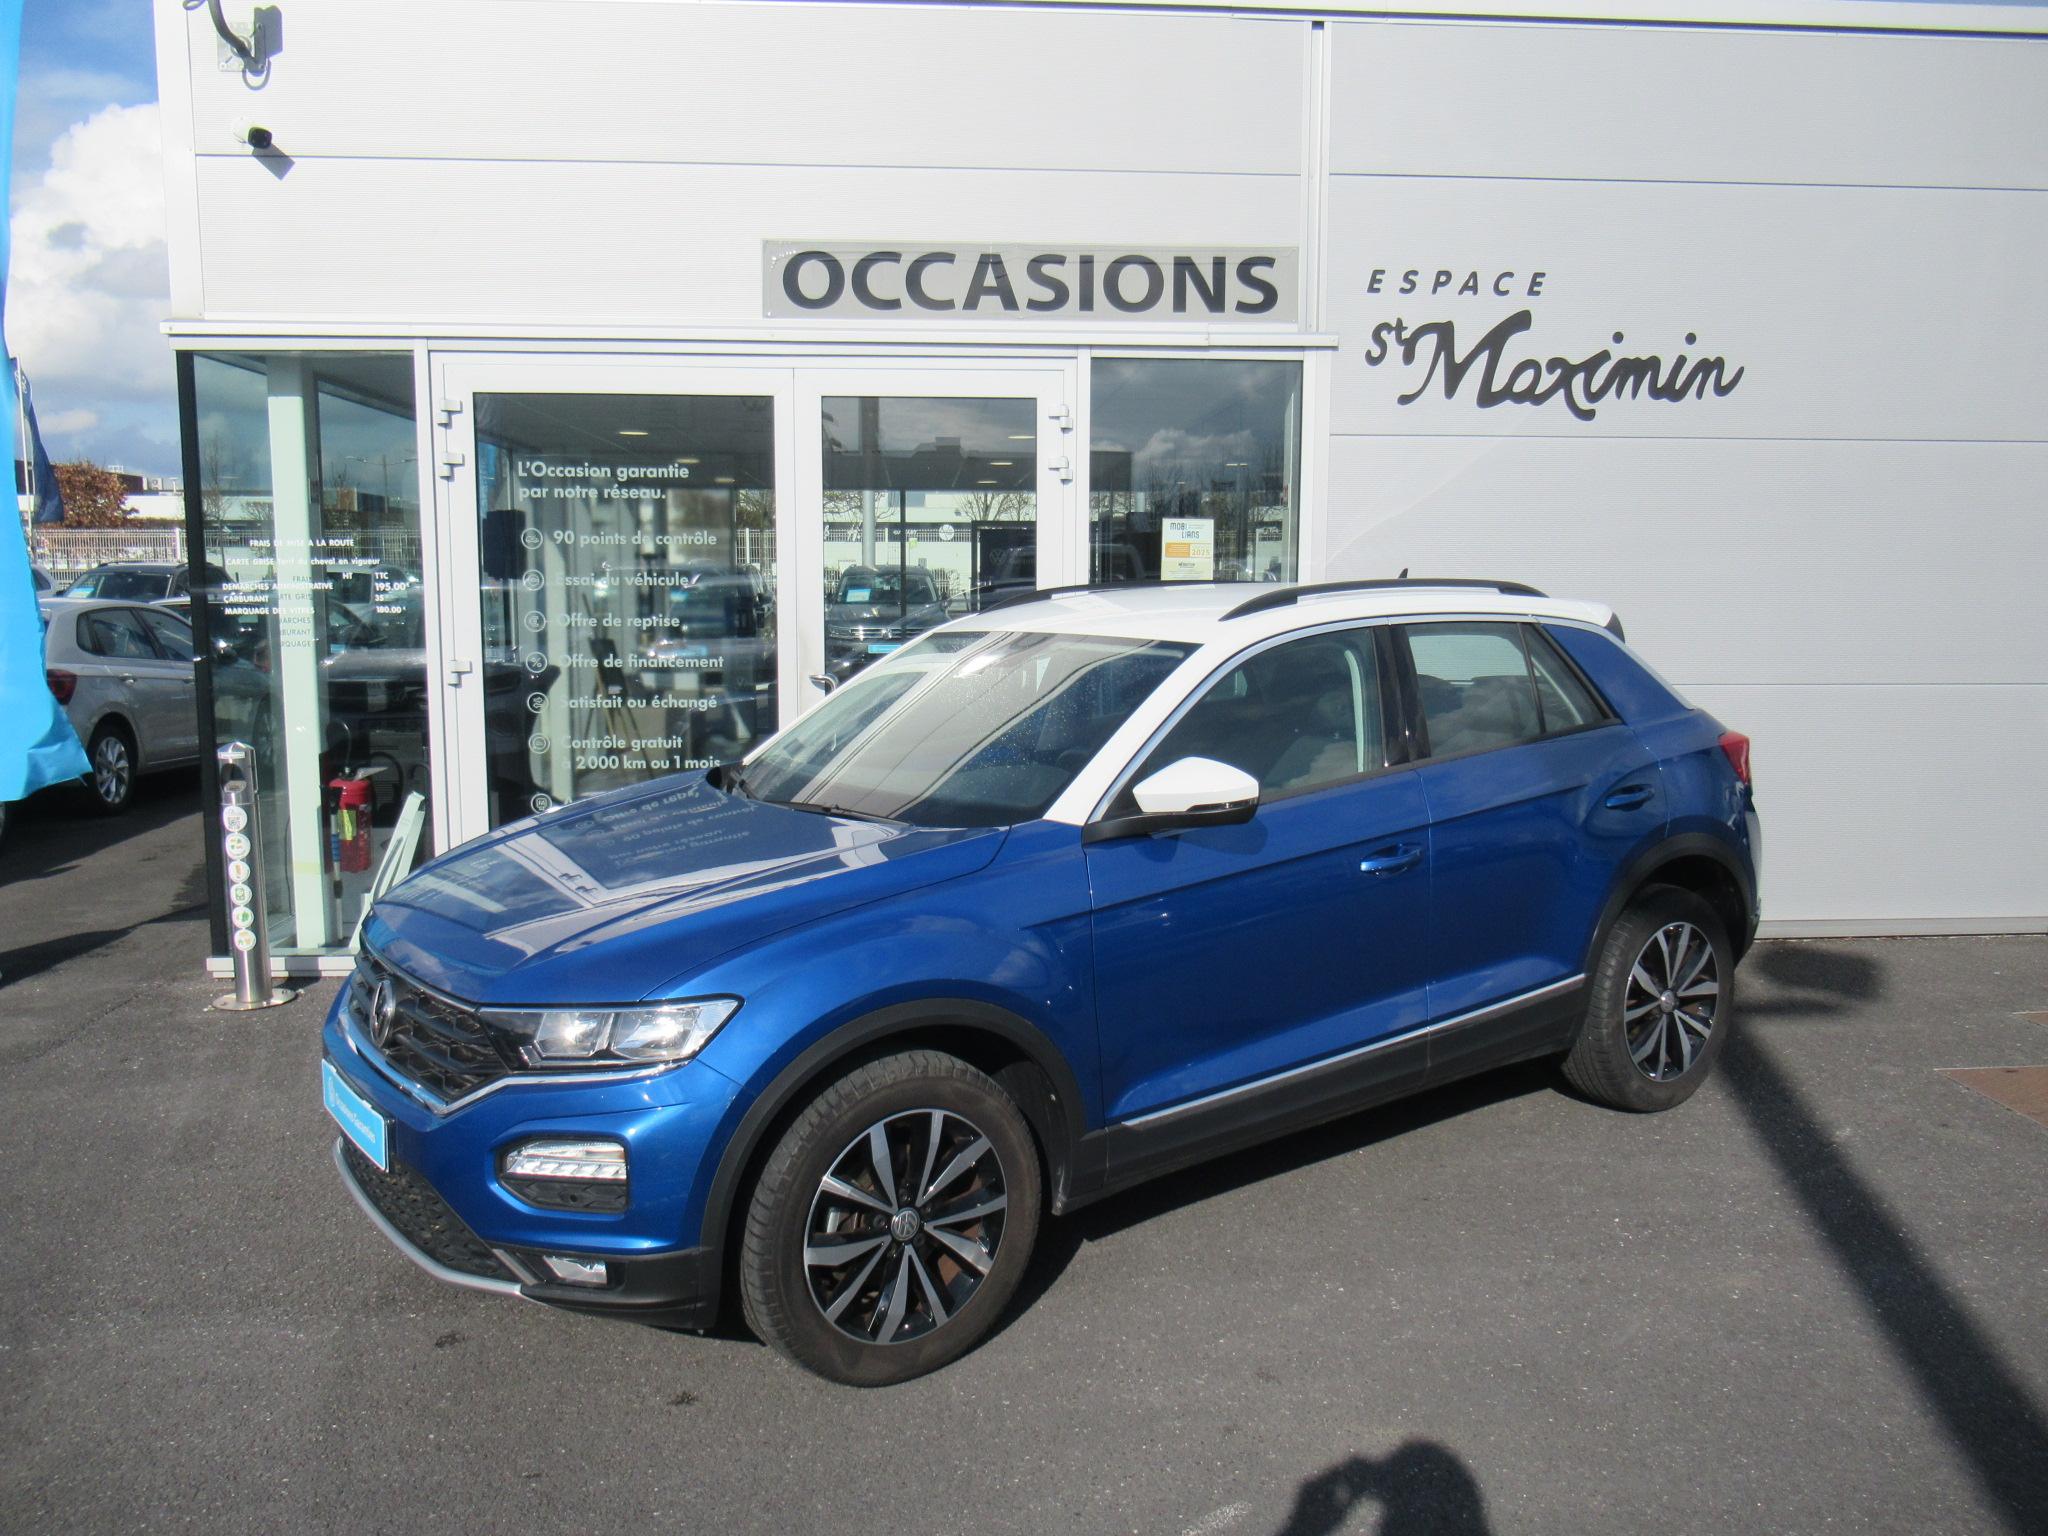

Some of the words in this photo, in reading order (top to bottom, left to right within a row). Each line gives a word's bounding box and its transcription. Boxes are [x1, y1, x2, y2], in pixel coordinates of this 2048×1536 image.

[782, 250, 1279, 315] OCCASIONS
[1367, 269, 1546, 297] ESPACE
[1365, 317, 1408, 367] St
[1396, 309, 1745, 422] Maximin
[517, 461, 612, 478] L'Occasion
[617, 462, 690, 481] garantie
[520, 487, 547, 502] par
[554, 484, 598, 499] notre
[604, 483, 666, 499] réseau.
[249, 539, 271, 547] FRAIS
[308, 539, 314, 547] A
[316, 539, 326, 547] LA
[329, 539, 355, 547] ROUTE
[552, 530, 574, 545] 90
[580, 530, 626, 548] points
[631, 530, 651, 545] de
[655, 530, 717, 546] contrôle
[226, 558, 250, 566] CARTE
[252, 558, 275, 566] GRISE
[310, 557, 336, 565] cheval
[351, 557, 381, 567] vigueur
[342, 572, 353, 580] HT
[374, 572, 389, 580] TTC
[600, 571, 620, 586] du
[625, 571, 690, 586] véhicule
[222, 582, 270, 591] DEMARCHES
[223, 595, 269, 603] CARBURANT
[374, 594, 385, 602] 35
[224, 607, 270, 615] MARQUAGE
[558, 613, 598, 627] Offre
[602, 613, 622, 627] de
[626, 613, 681, 631] reprise
[559, 654, 599, 668] Offre
[603, 654, 623, 668] de
[628, 654, 725, 668] financement
[559, 694, 623, 709] Satisfait
[627, 698, 647, 709] ou
[651, 694, 718, 712] échangé
[560, 734, 626, 750] Contrôle
[631, 735, 683, 752] gratuit
[623, 755, 647, 770] km
[650, 758, 670, 770] ou
[673, 756, 682, 770] 1
[684, 756, 721, 770] mois
